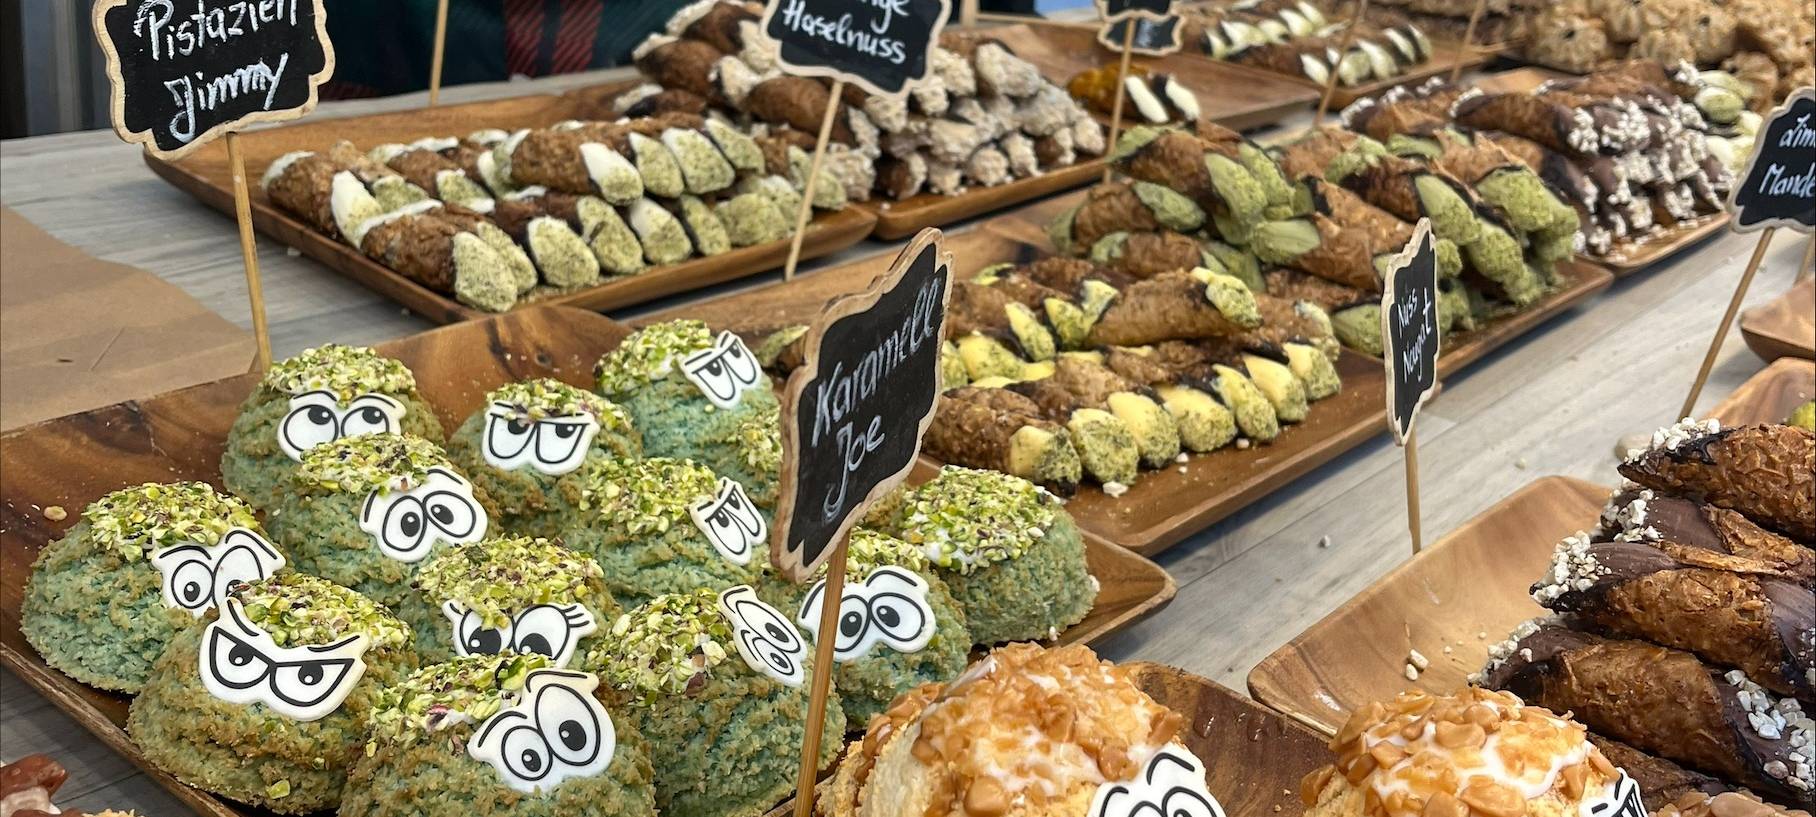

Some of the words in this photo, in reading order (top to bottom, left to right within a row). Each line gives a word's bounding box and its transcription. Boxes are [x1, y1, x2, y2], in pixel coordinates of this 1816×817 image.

[133, 0, 297, 61] Pistazien
[164, 53, 289, 143] Jimmy
[1397, 287, 1418, 338] Nuss
[1402, 287, 1432, 384] Nougat
[811, 278, 942, 447] Karamell
[822, 415, 886, 524] Joe
